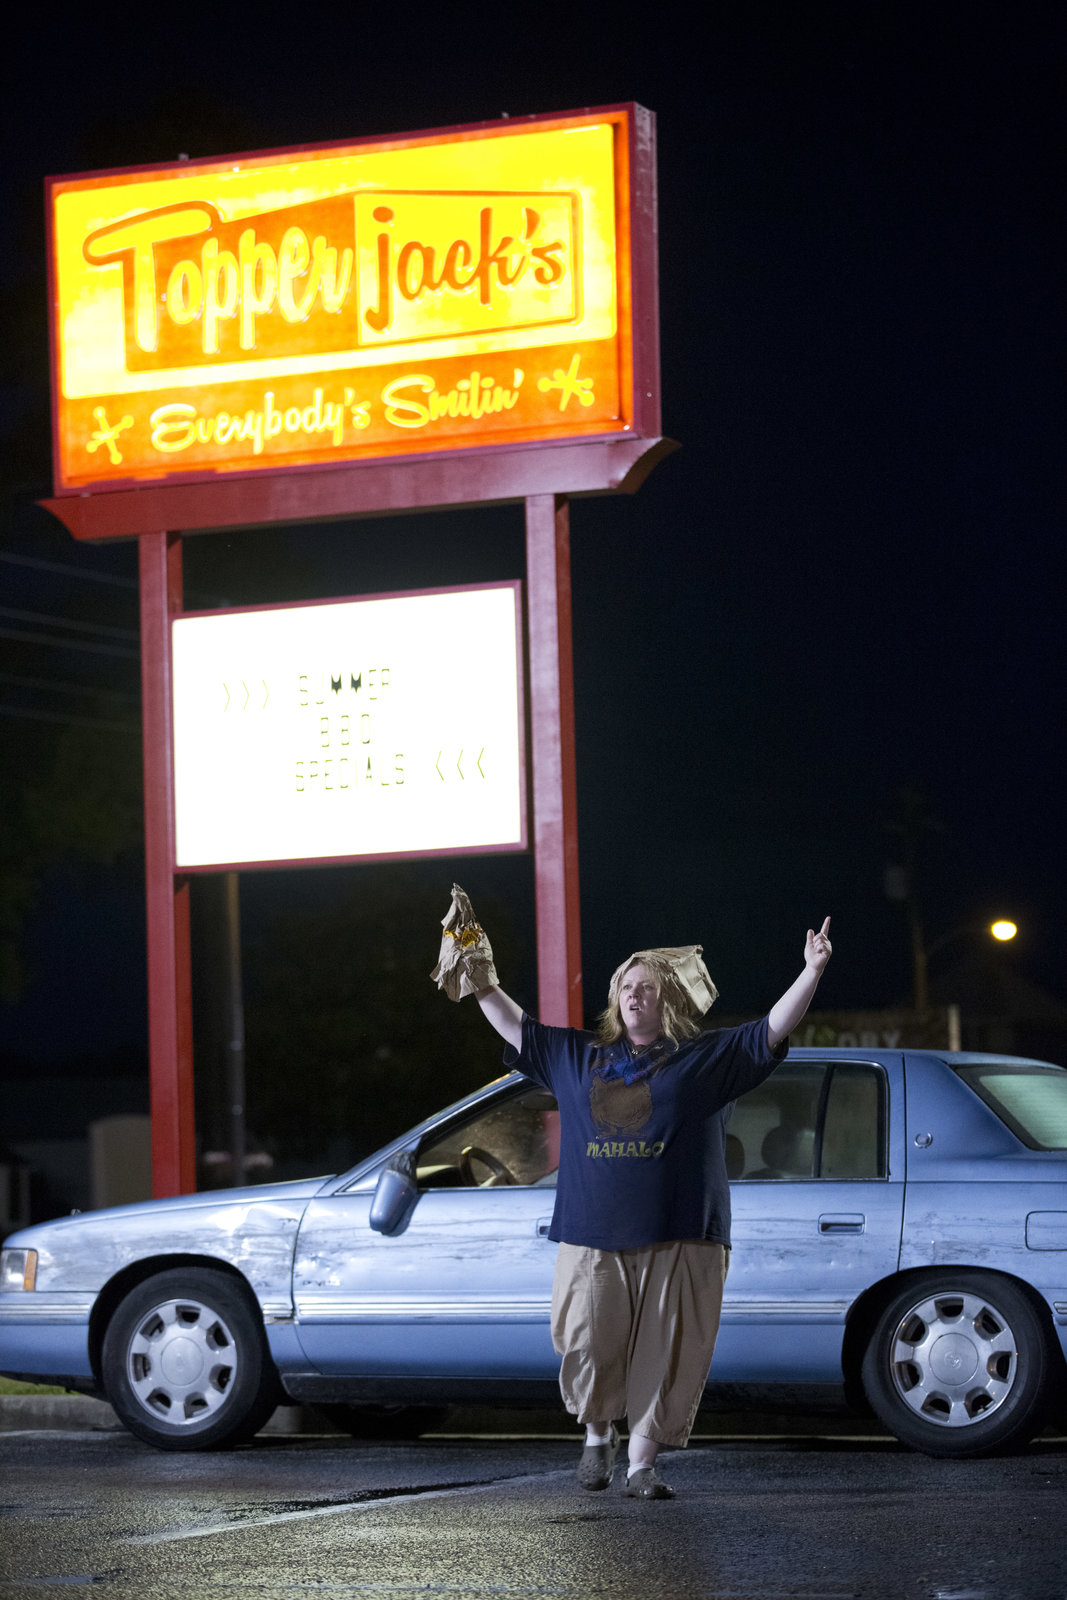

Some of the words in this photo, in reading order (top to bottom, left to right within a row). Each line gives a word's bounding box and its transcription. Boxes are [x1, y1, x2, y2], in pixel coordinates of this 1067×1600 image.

[84, 202, 354, 353] Topper
[364, 206, 565, 332] jack's
[149, 388, 371, 455] Everybody's
[381, 368, 525, 429] Smilin'
[299, 668, 391, 707] SUMMER
[296, 753, 405, 792] SPECIALS
[586, 1141, 665, 1158] MAHALO
